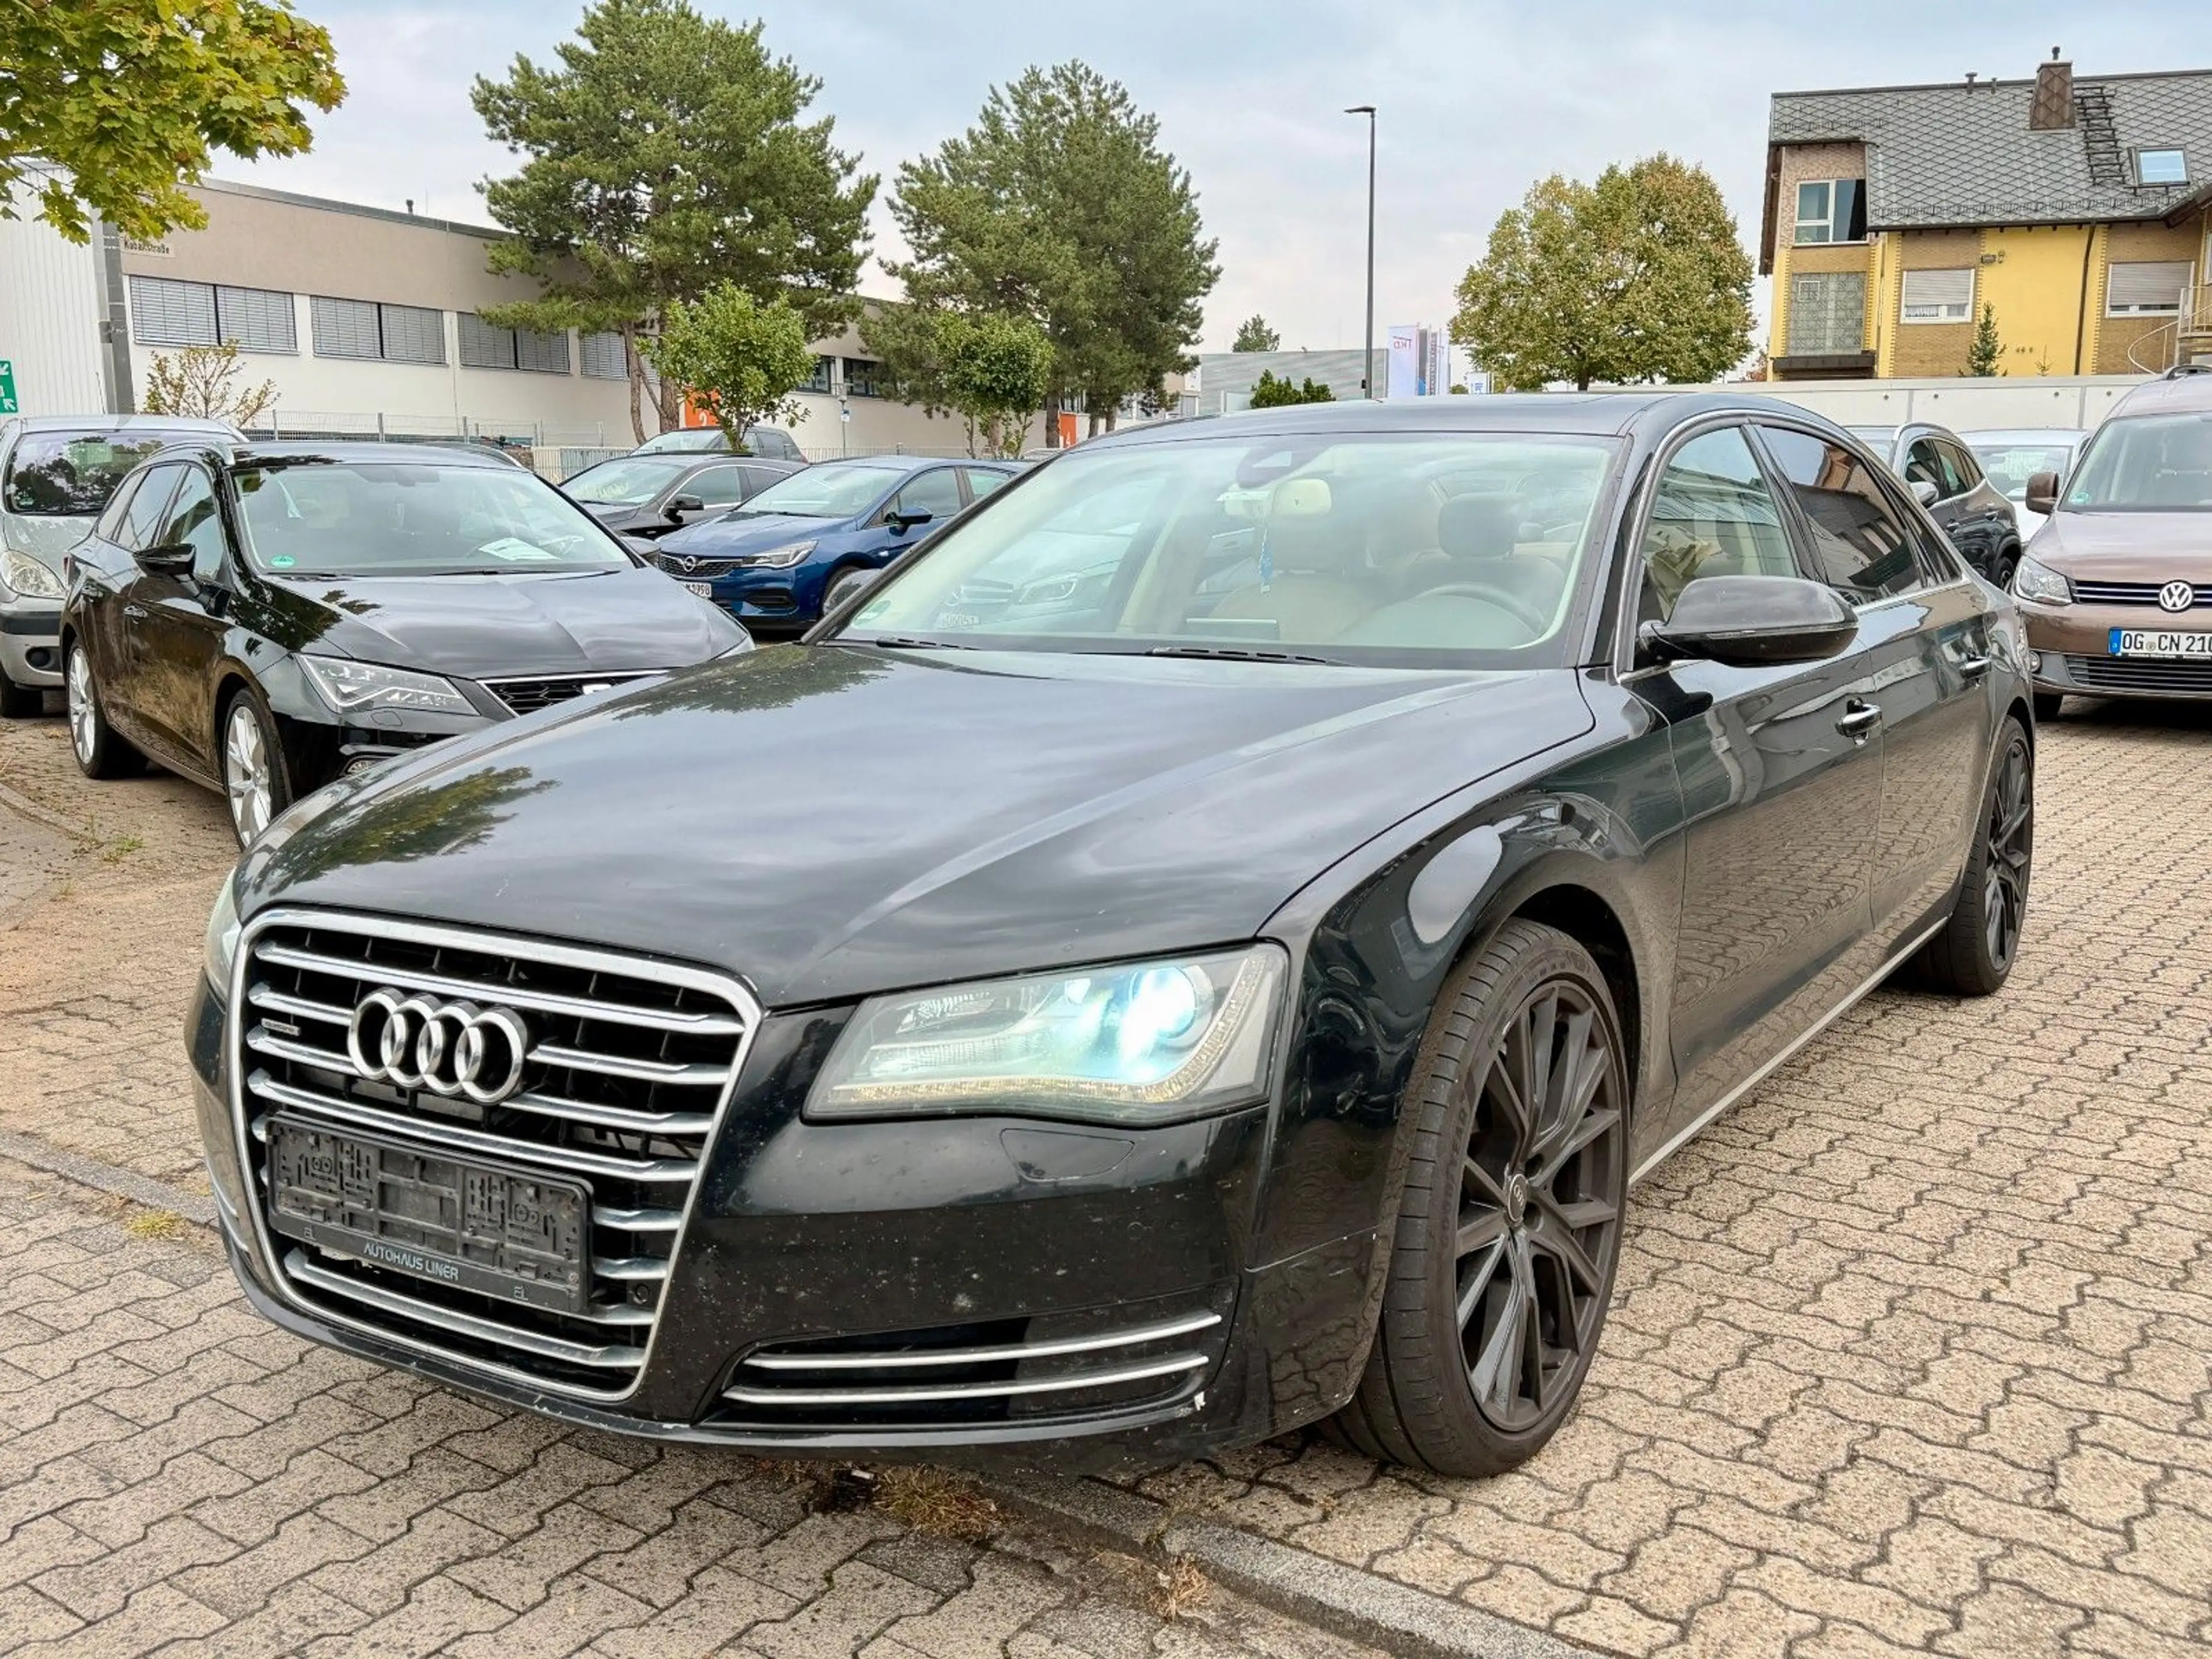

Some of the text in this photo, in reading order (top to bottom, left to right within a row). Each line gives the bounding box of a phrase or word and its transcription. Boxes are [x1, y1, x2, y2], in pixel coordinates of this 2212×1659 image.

[2123, 633, 2145, 650] OG
[2158, 634, 2181, 652] CN
[363, 1241, 459, 1281] AUTOHAUS LINER
